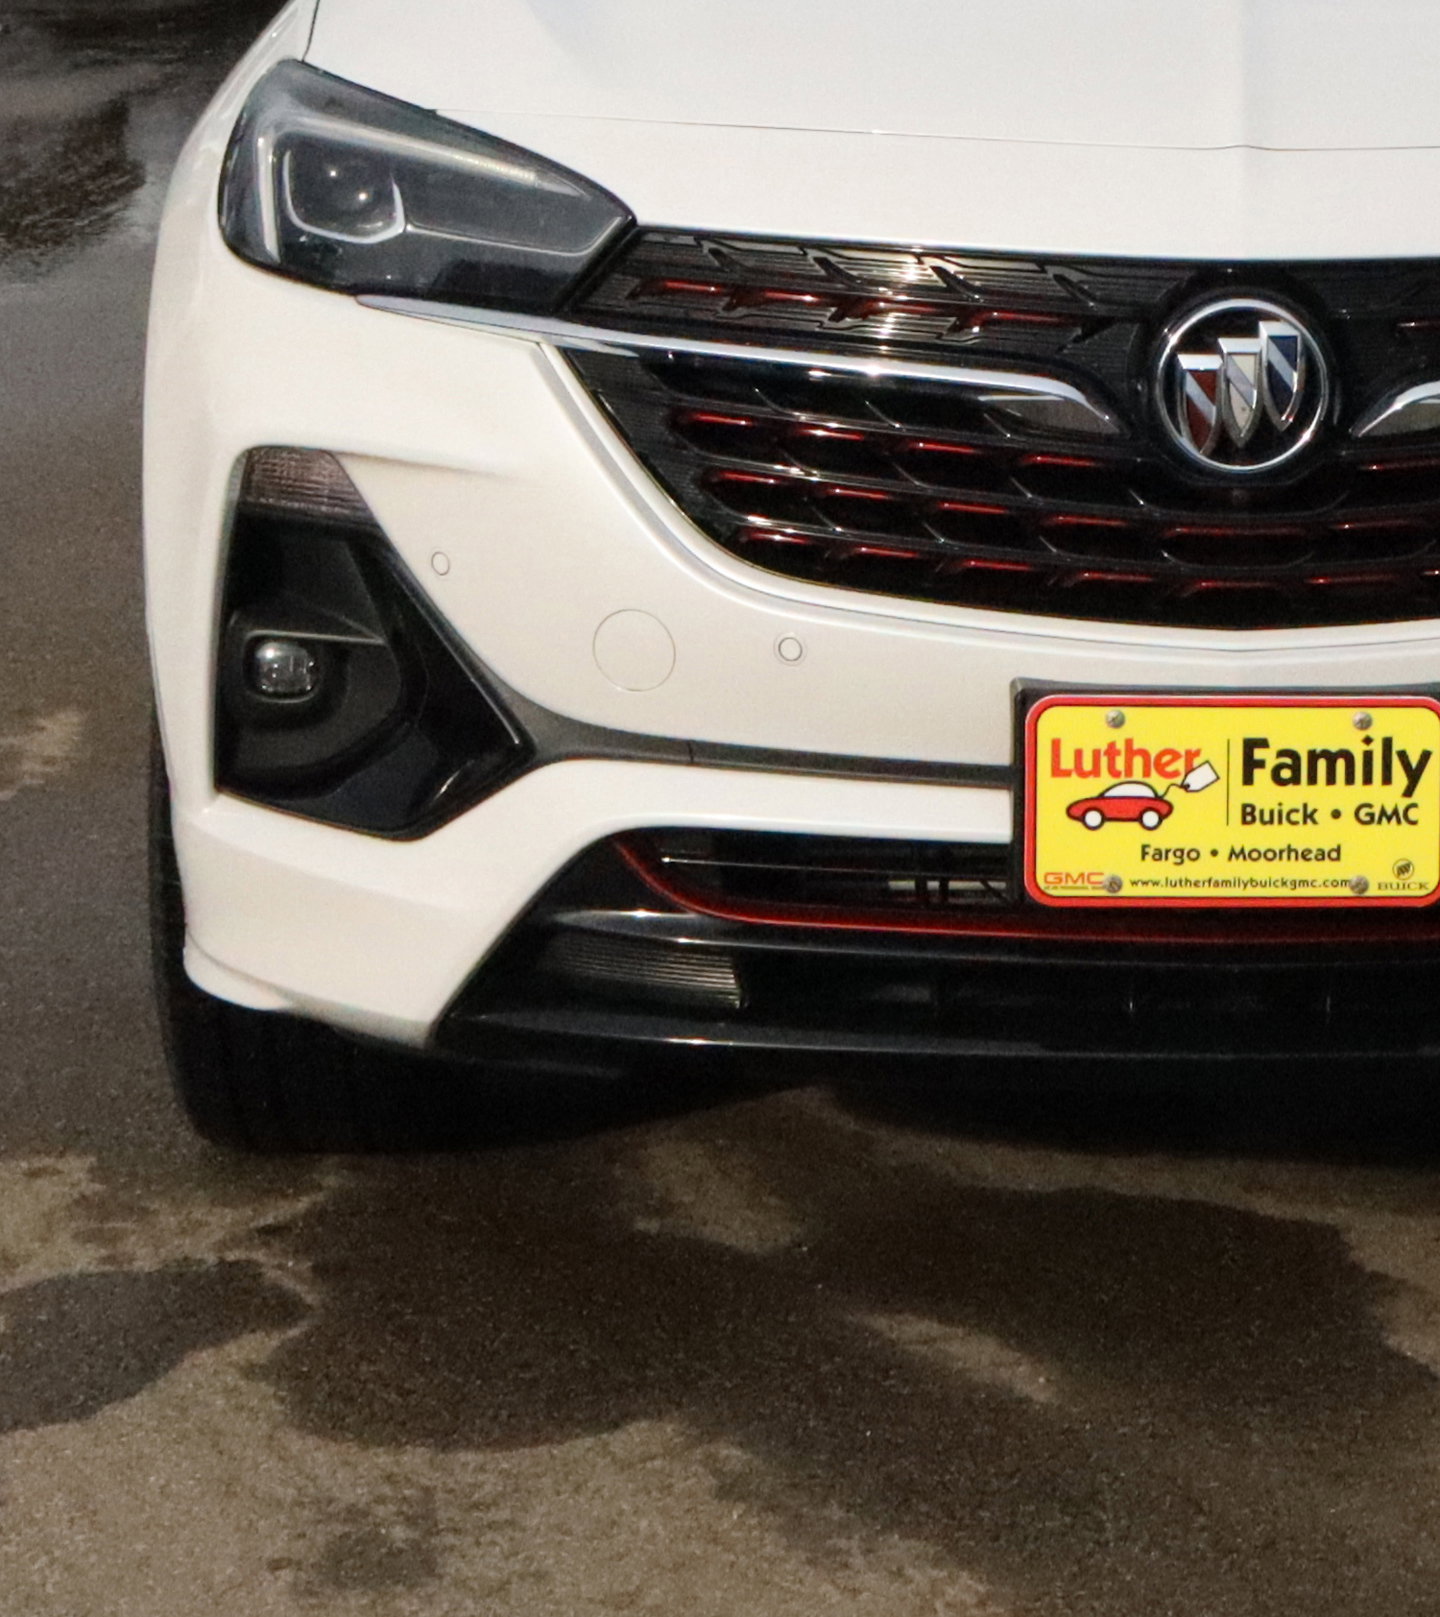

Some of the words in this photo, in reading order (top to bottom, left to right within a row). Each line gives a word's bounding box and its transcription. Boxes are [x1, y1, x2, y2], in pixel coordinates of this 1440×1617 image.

[1051, 737, 1201, 779] Luther
[1241, 735, 1432, 798] Family
[1241, 802, 1319, 826] Buick
[1353, 803, 1419, 826] GMC
[1141, 844, 1201, 865] Fargo
[1228, 844, 1341, 863] Moorhead
[1044, 872, 1105, 884] GMC
[1129, 875, 1351, 891] www.lutherfamilybuickgmc.com
[1377, 882, 1429, 891] BUICK
